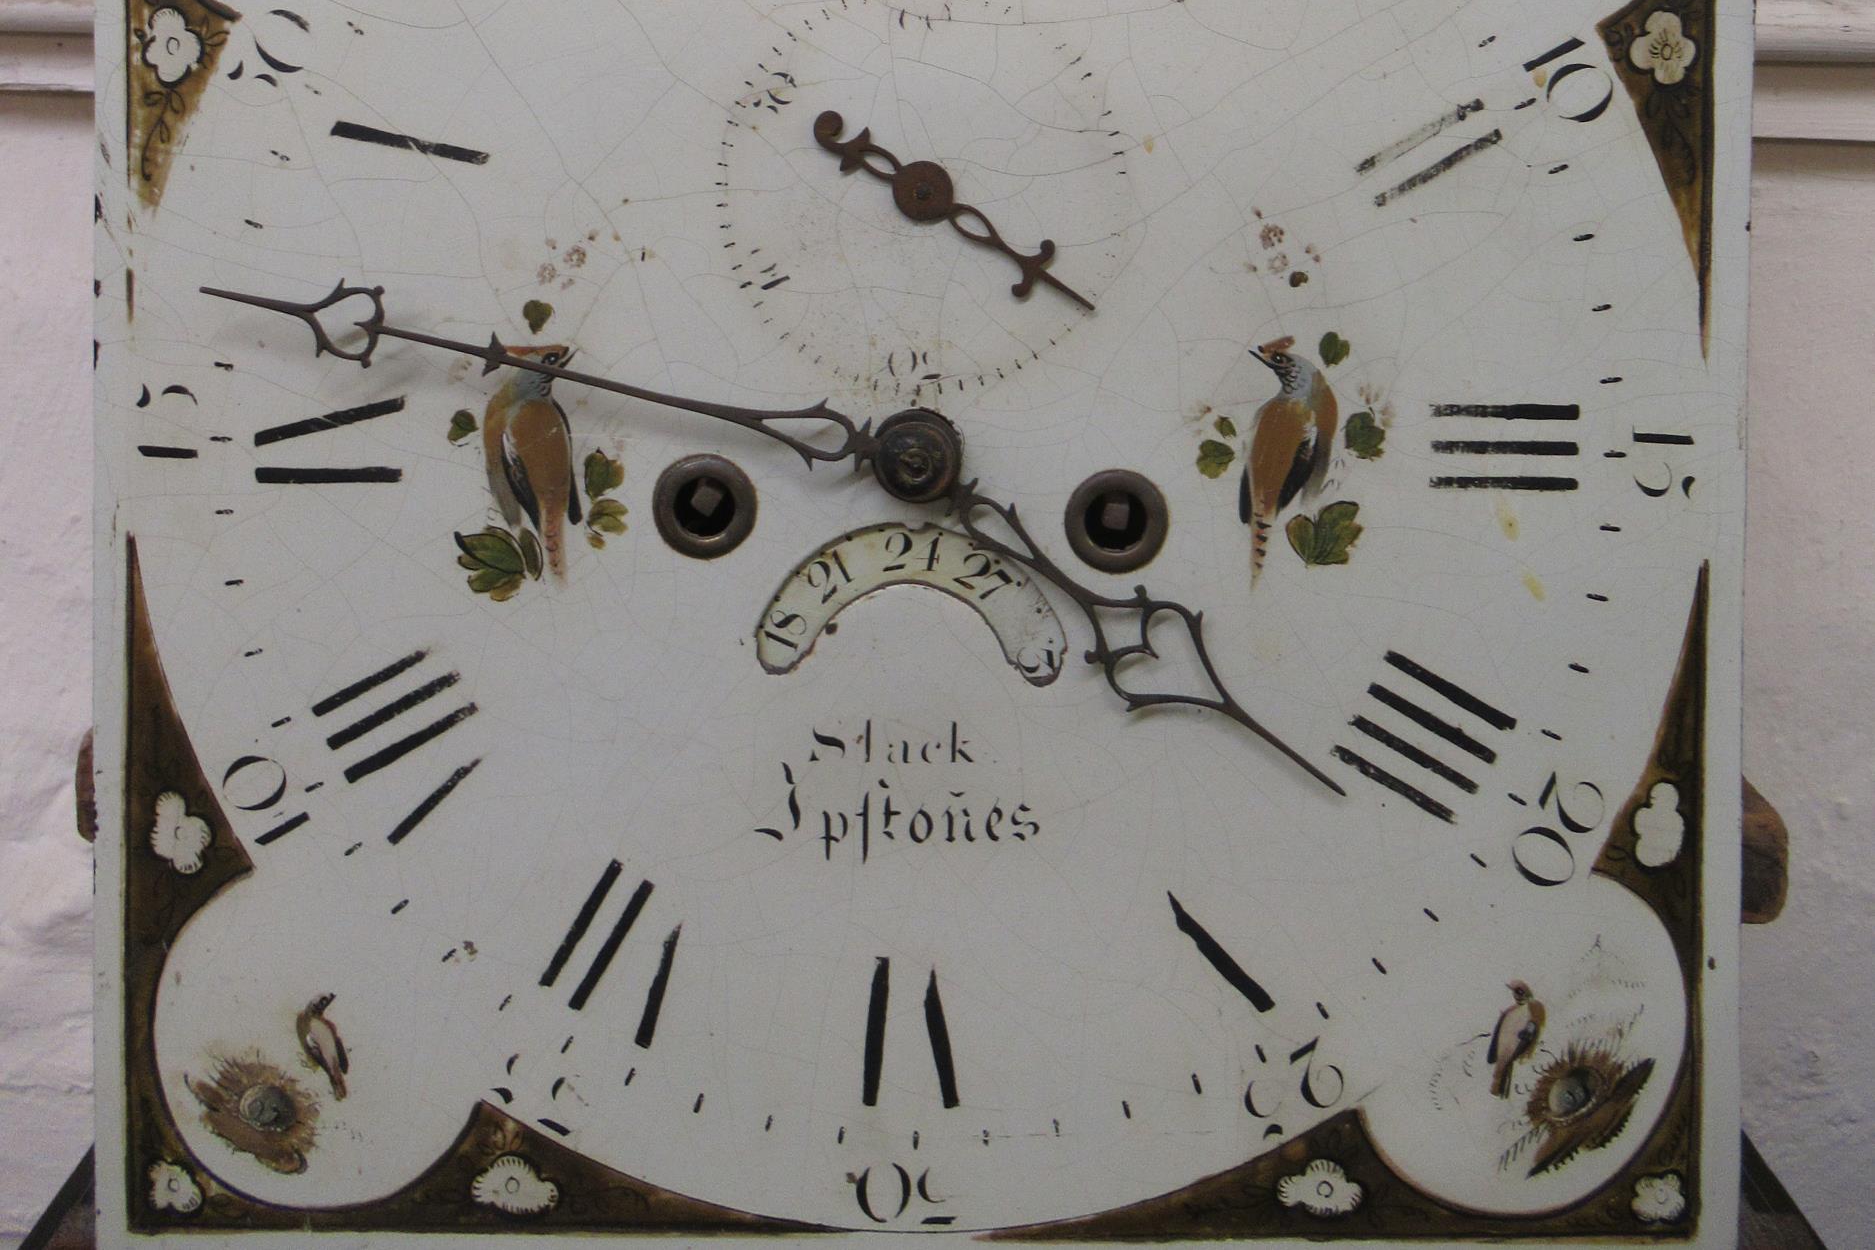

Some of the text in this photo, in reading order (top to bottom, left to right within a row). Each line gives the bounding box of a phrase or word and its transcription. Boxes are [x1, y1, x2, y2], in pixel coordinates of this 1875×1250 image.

[1522, 36, 1614, 123] 10
[1428, 402, 1581, 491] III
[763, 609, 808, 650] 18
[806, 549, 855, 605] 21
[882, 531, 945, 573] 24
[953, 552, 1015, 601] 27
[1511, 771, 1605, 887] 20
